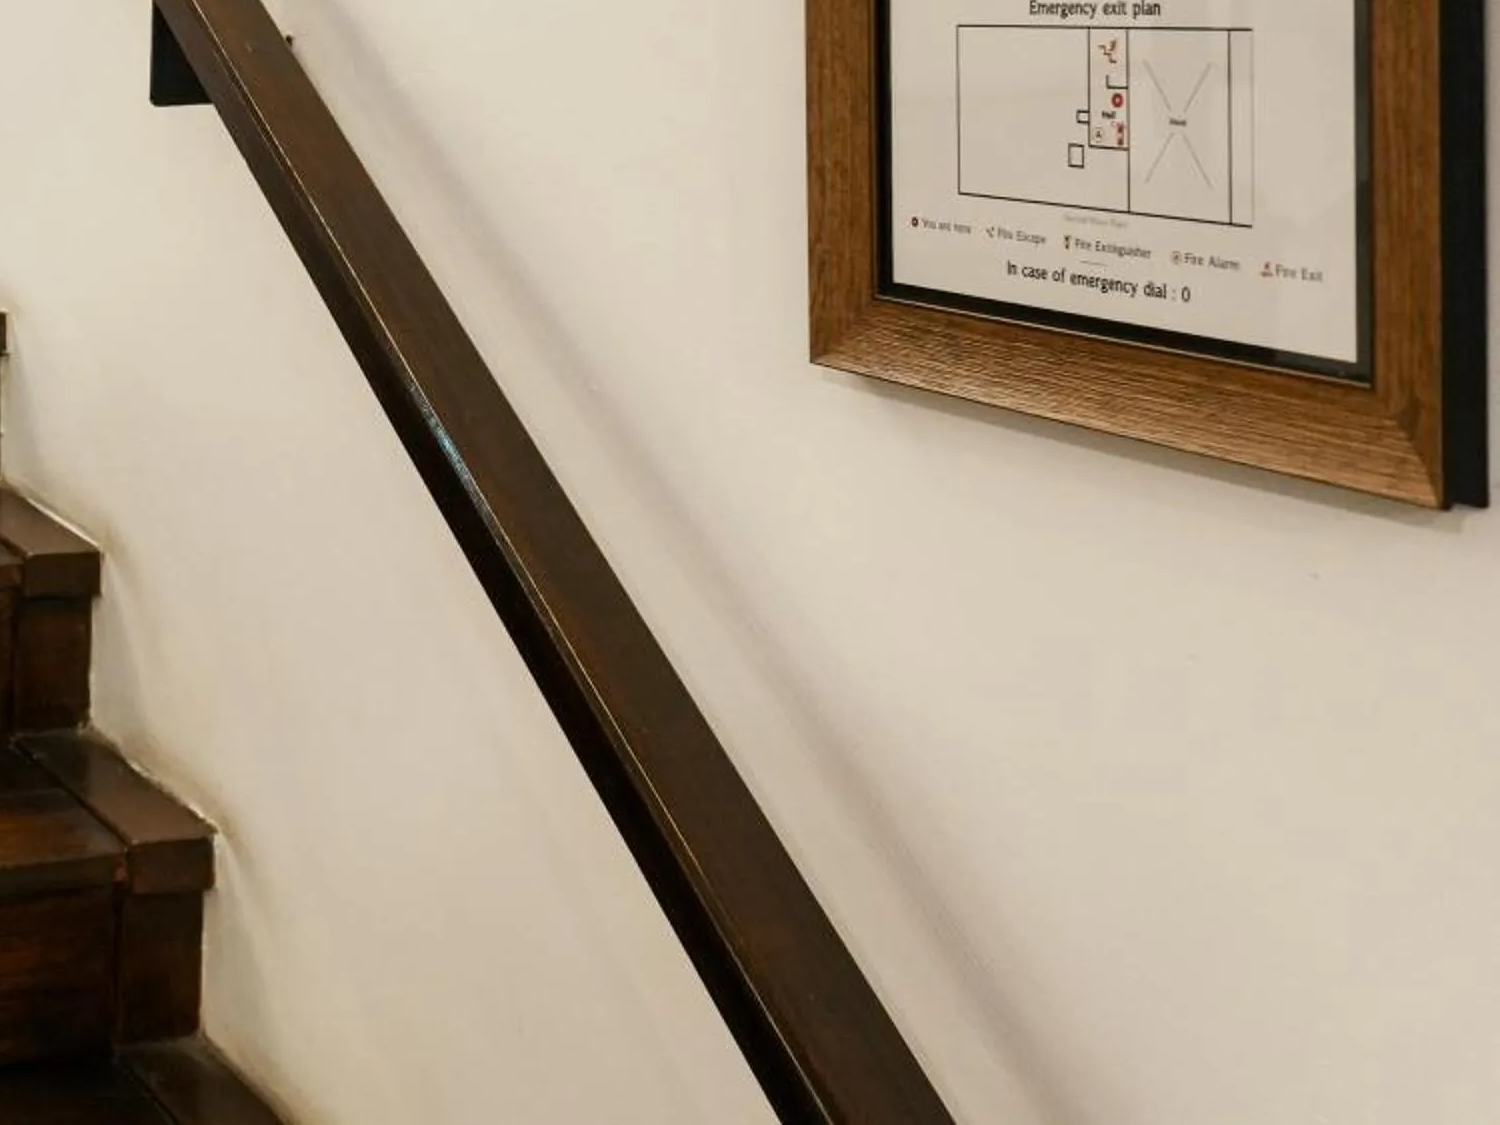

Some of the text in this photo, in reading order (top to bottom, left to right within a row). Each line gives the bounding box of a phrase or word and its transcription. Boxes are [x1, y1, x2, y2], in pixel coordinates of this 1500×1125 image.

[1029, 0, 1161, 20] Emergency exit plan
[1016, 230, 1046, 246] Escape
[1075, 238, 1152, 259] Fire Extinguisher
[1184, 252, 1240, 271] Fire Alarm
[1007, 260, 1017, 275] In
[1021, 264, 1048, 280] case
[1052, 267, 1066, 282] of
[1070, 272, 1138, 298] emergency
[1143, 280, 1167, 300] dial
[1181, 286, 1192, 303] 0
[1275, 264, 1323, 282] Fire Exit
